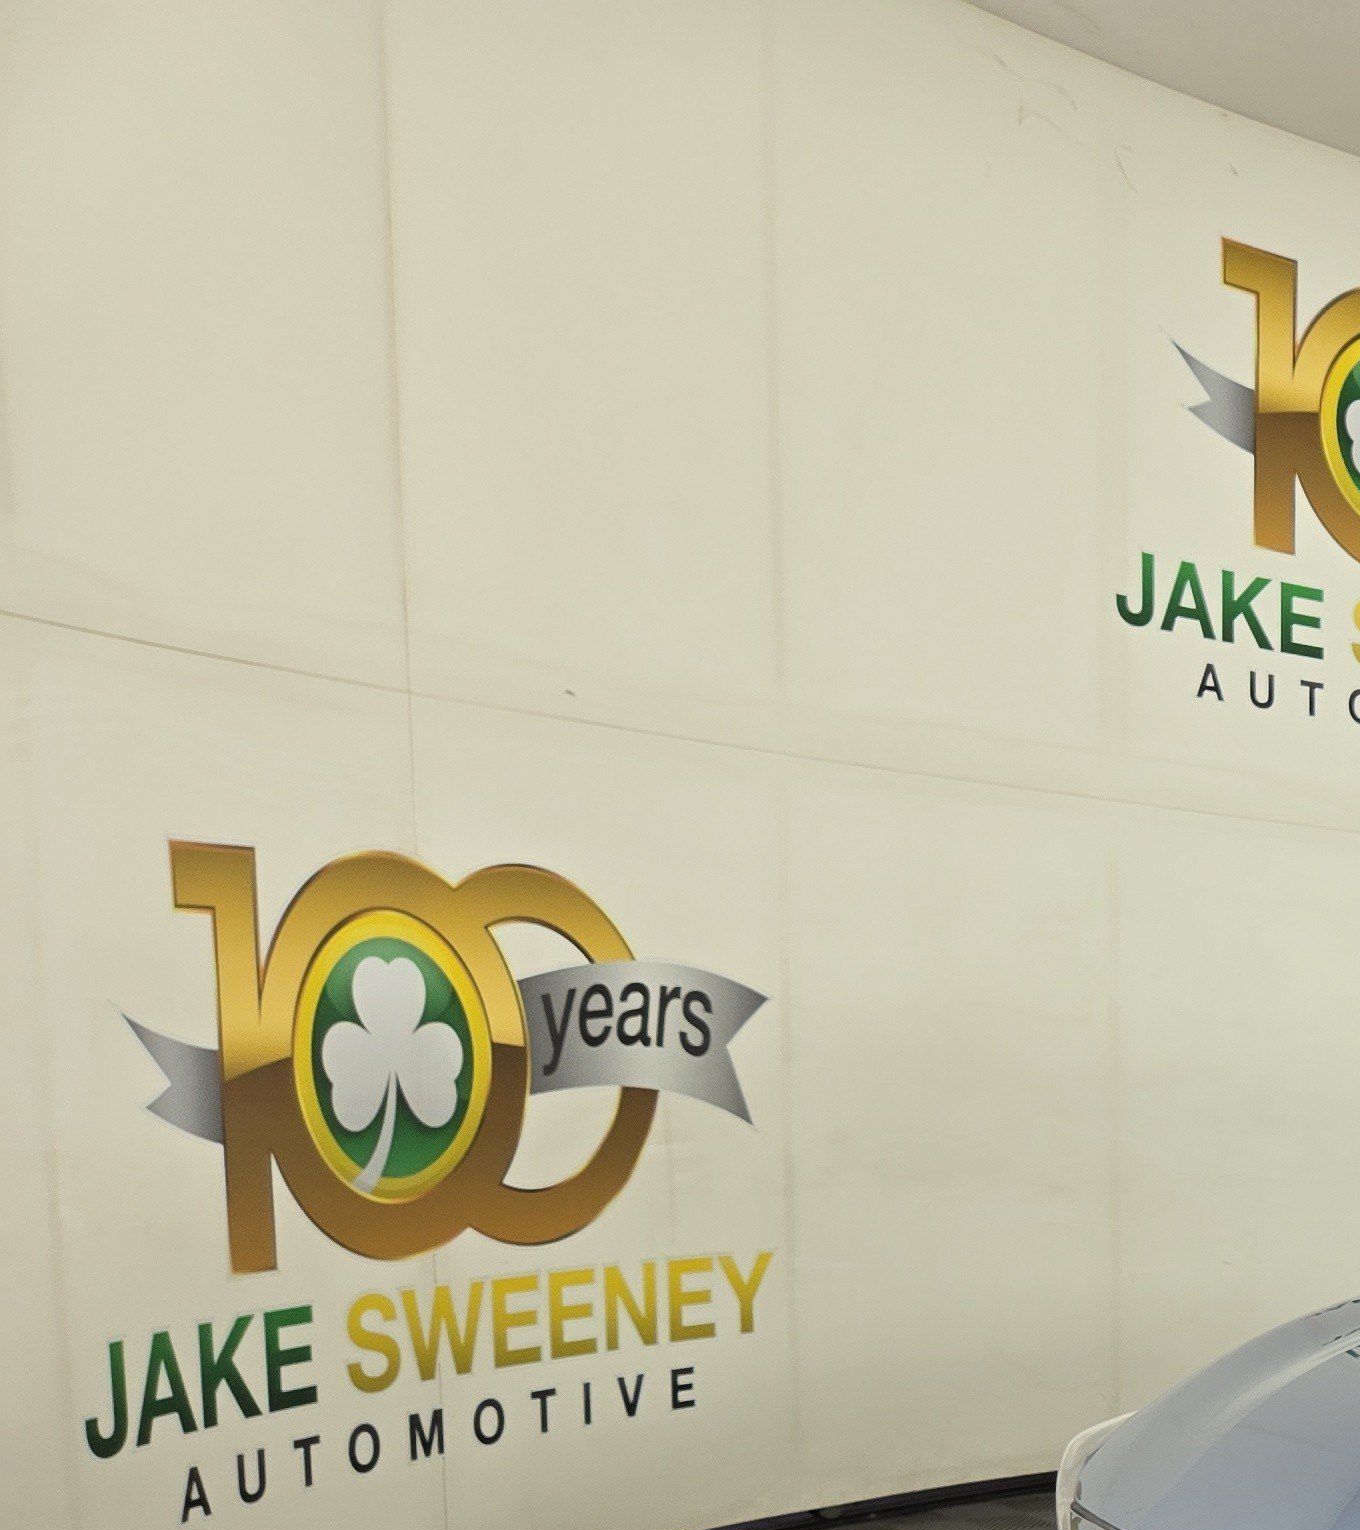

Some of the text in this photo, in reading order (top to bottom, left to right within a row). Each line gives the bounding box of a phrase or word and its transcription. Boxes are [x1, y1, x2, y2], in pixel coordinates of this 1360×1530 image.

[1114, 550, 1325, 661] JAKE
[168, 838, 660, 1276] 100
[539, 980, 713, 1076] years
[84, 1250, 775, 1460] JAKE SWEENEY
[180, 1366, 696, 1525] AUTOMOTIVE
